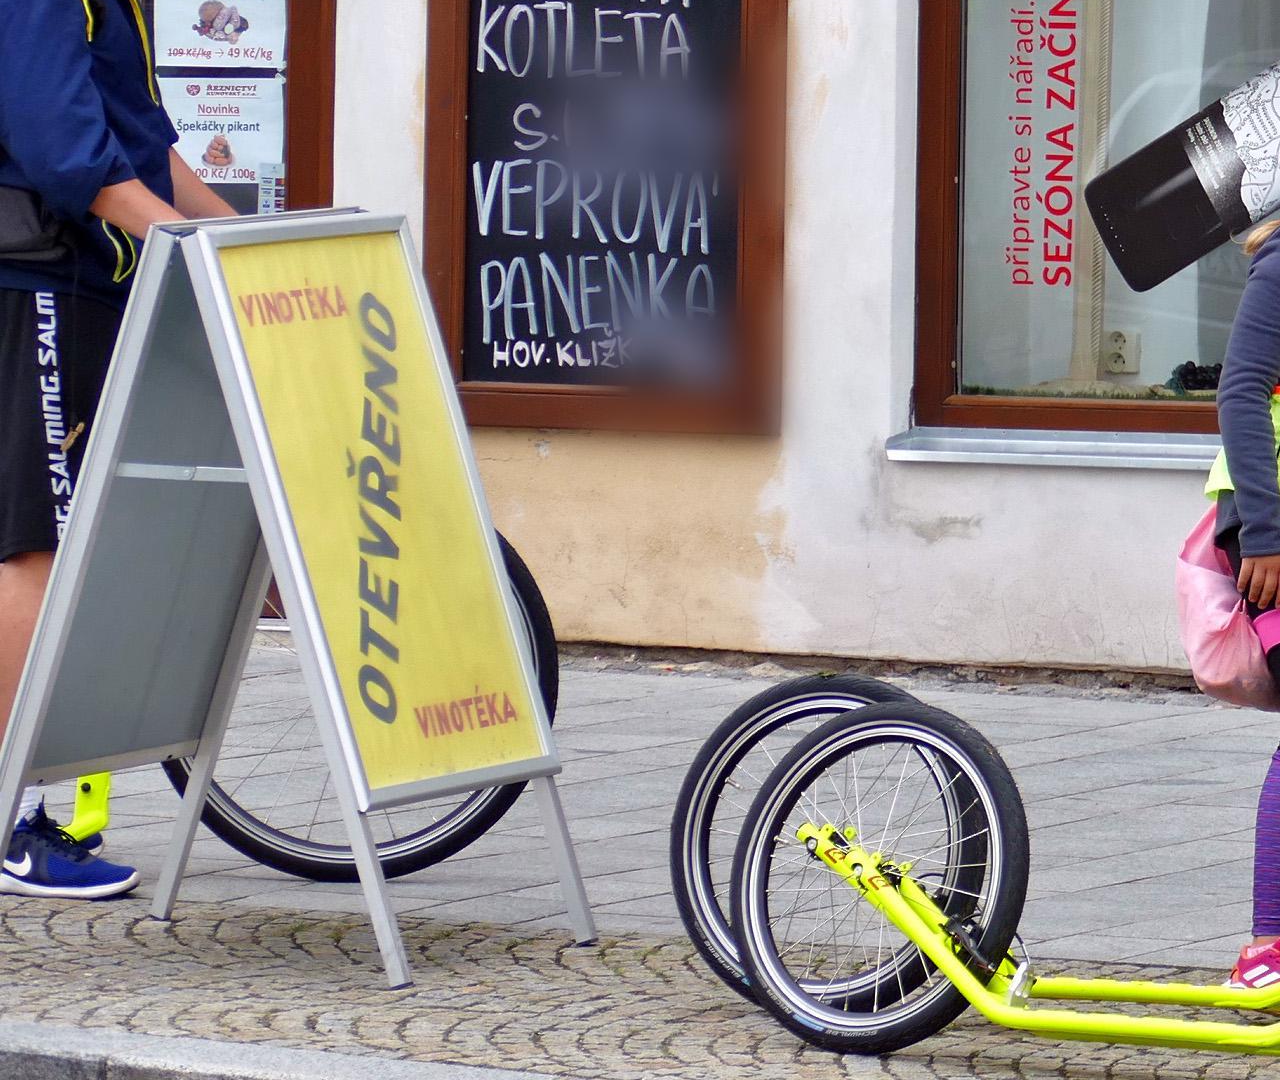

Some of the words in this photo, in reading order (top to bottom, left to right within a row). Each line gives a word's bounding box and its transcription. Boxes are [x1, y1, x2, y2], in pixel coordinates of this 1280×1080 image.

[228, 48, 240, 57] 49
[243, 47, 272, 60] Kč/kg
[177, 118, 225, 133] Špekáčky
[228, 121, 260, 133] pikant
[198, 104, 240, 114] Novinka
[1008, 116, 1032, 136] si
[1004, 146, 1035, 287] připravte
[1036, 123, 1075, 288] SEZÓNA
[238, 277, 348, 327] VINOTÉKA
[480, 251, 716, 344] PANENKA
[346, 291, 400, 724] OTEVŘENO
[414, 685, 518, 739] VINOTÉKA
